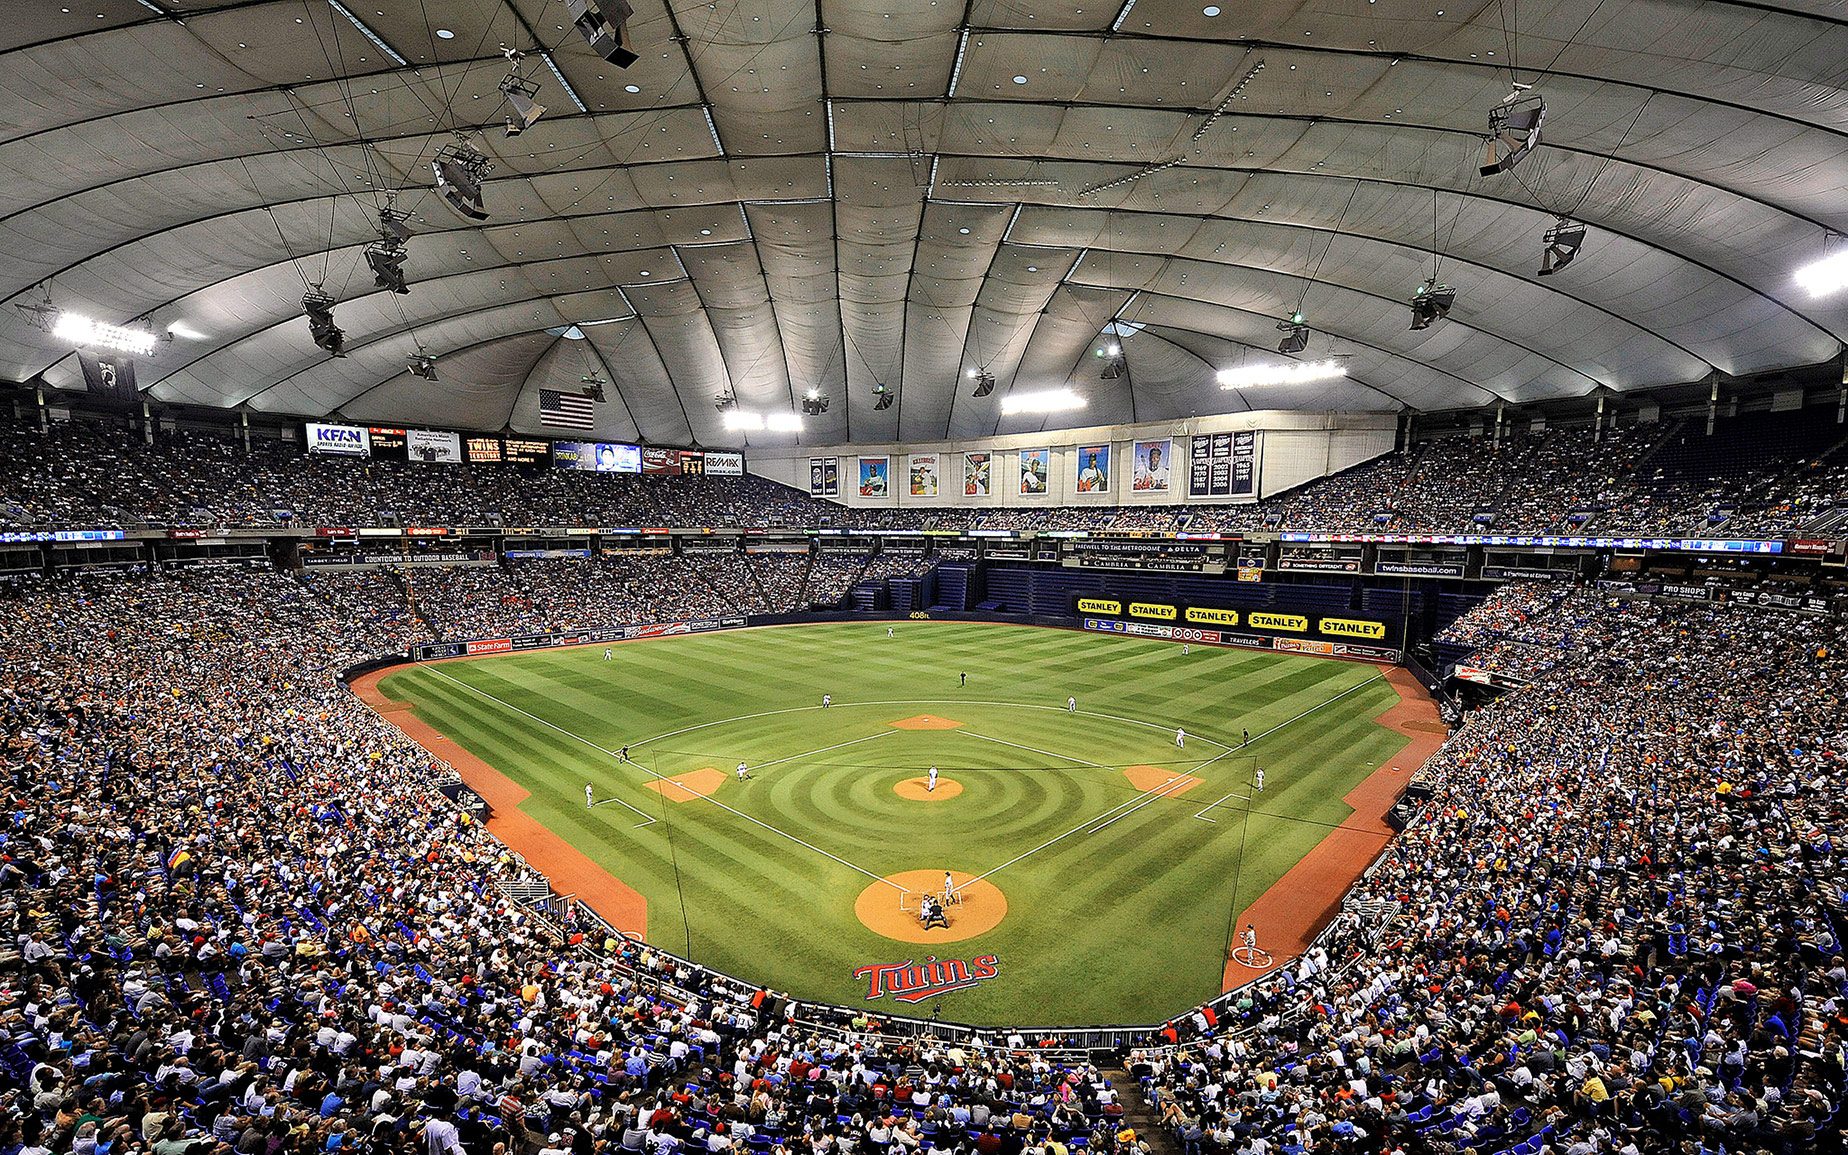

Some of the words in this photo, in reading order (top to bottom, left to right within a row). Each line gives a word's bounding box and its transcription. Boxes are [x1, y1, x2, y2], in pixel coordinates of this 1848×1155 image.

[317, 428, 361, 443] KFAN
[469, 442, 500, 451] TWINS
[706, 457, 739, 468] RE/MAX
[1134, 478, 1151, 490] 34
[365, 556, 402, 564] COUNTDOWN
[1094, 560, 1128, 568] CAMBRIA
[1382, 565, 1457, 575] twinsbaseball.com
[1663, 585, 1678, 593] PRO
[1679, 586, 1706, 595] SHOPS
[1081, 602, 1118, 611] STANLEY
[1132, 606, 1173, 616] STANLEY
[1189, 610, 1234, 621] STANLEY
[1252, 616, 1303, 628] STANLEY
[633, 623, 673, 637] Budweiser
[1324, 621, 1380, 635] STANLEY
[1230, 637, 1260, 645] TRAVELERS
[853, 955, 998, 1000] Twins
